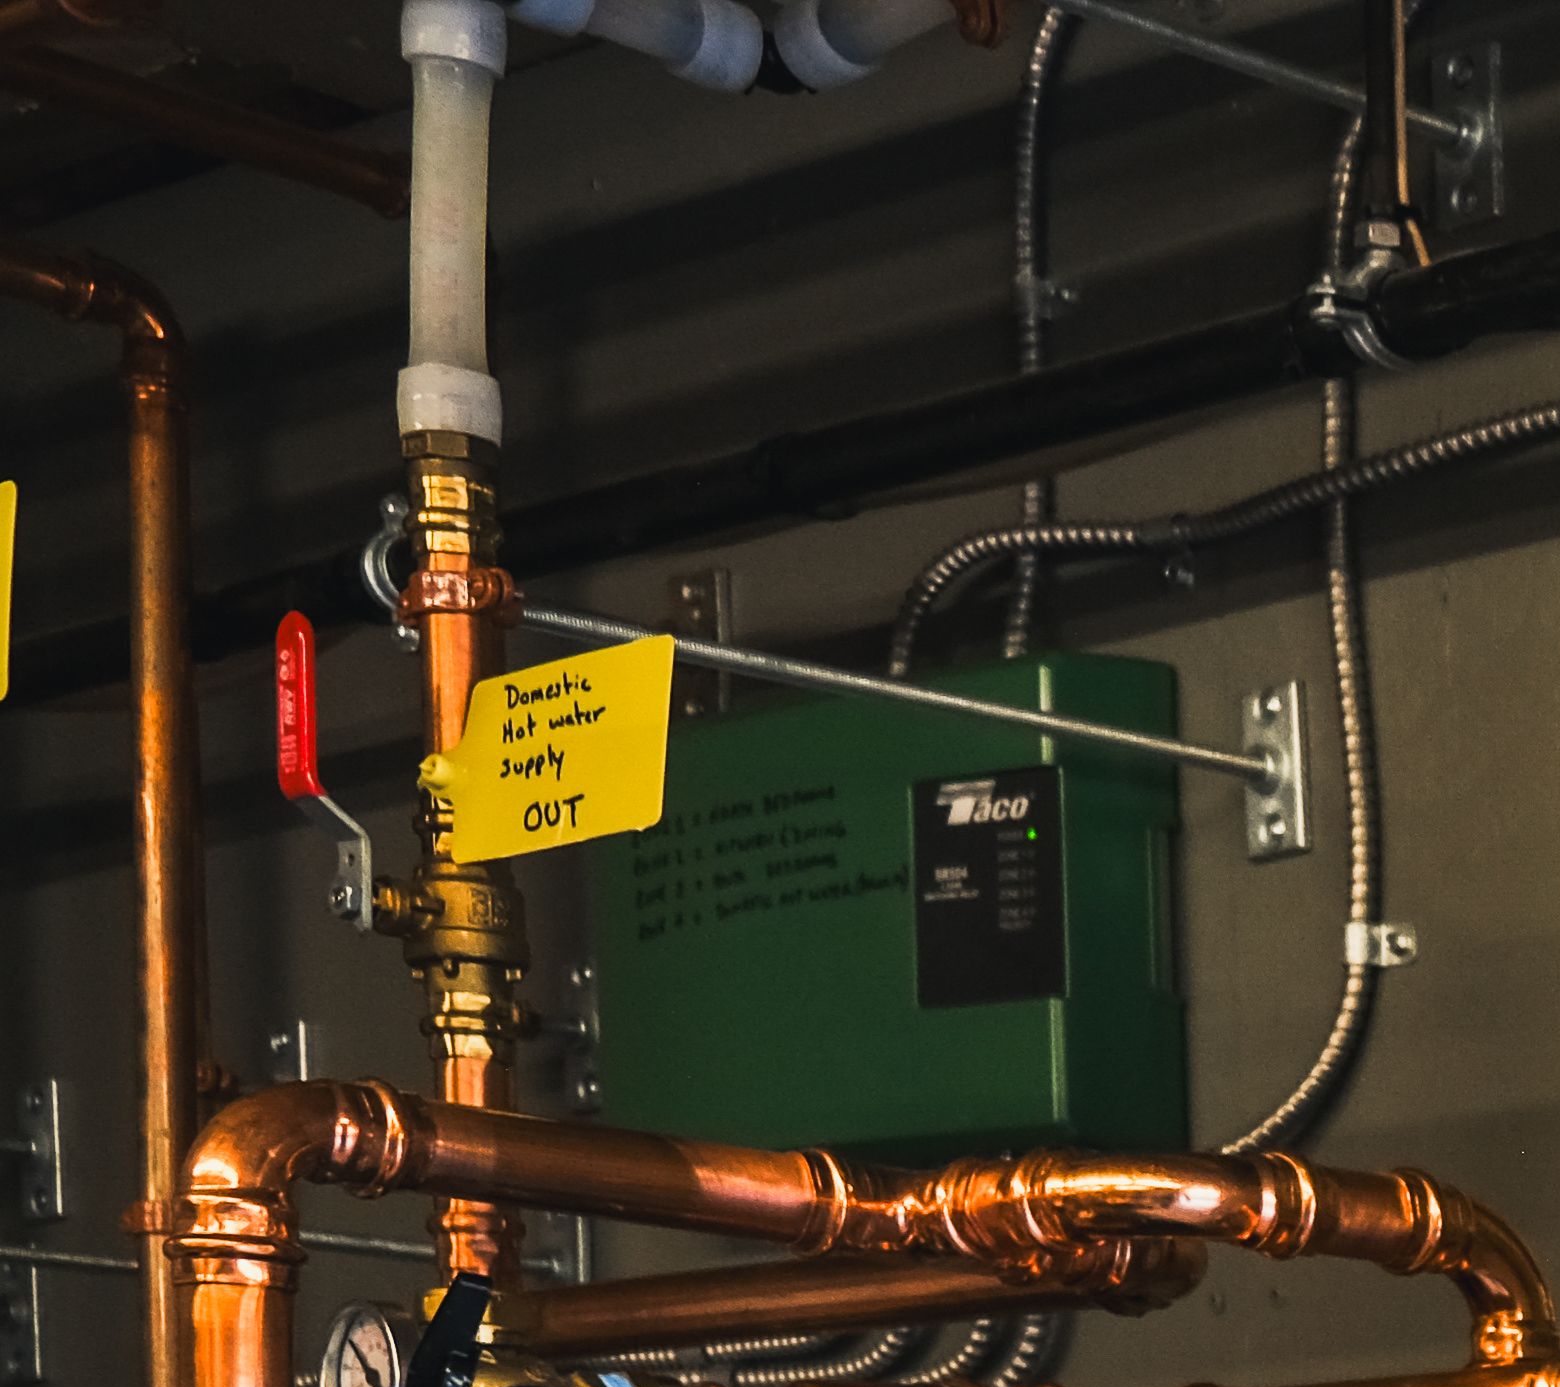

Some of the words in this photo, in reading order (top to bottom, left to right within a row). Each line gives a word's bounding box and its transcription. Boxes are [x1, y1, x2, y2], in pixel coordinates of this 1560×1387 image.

[504, 671, 592, 709] Domestic
[502, 712, 536, 744] Hot
[549, 701, 606, 730] water
[523, 793, 585, 832] OUT
[937, 780, 1028, 825] Taco
